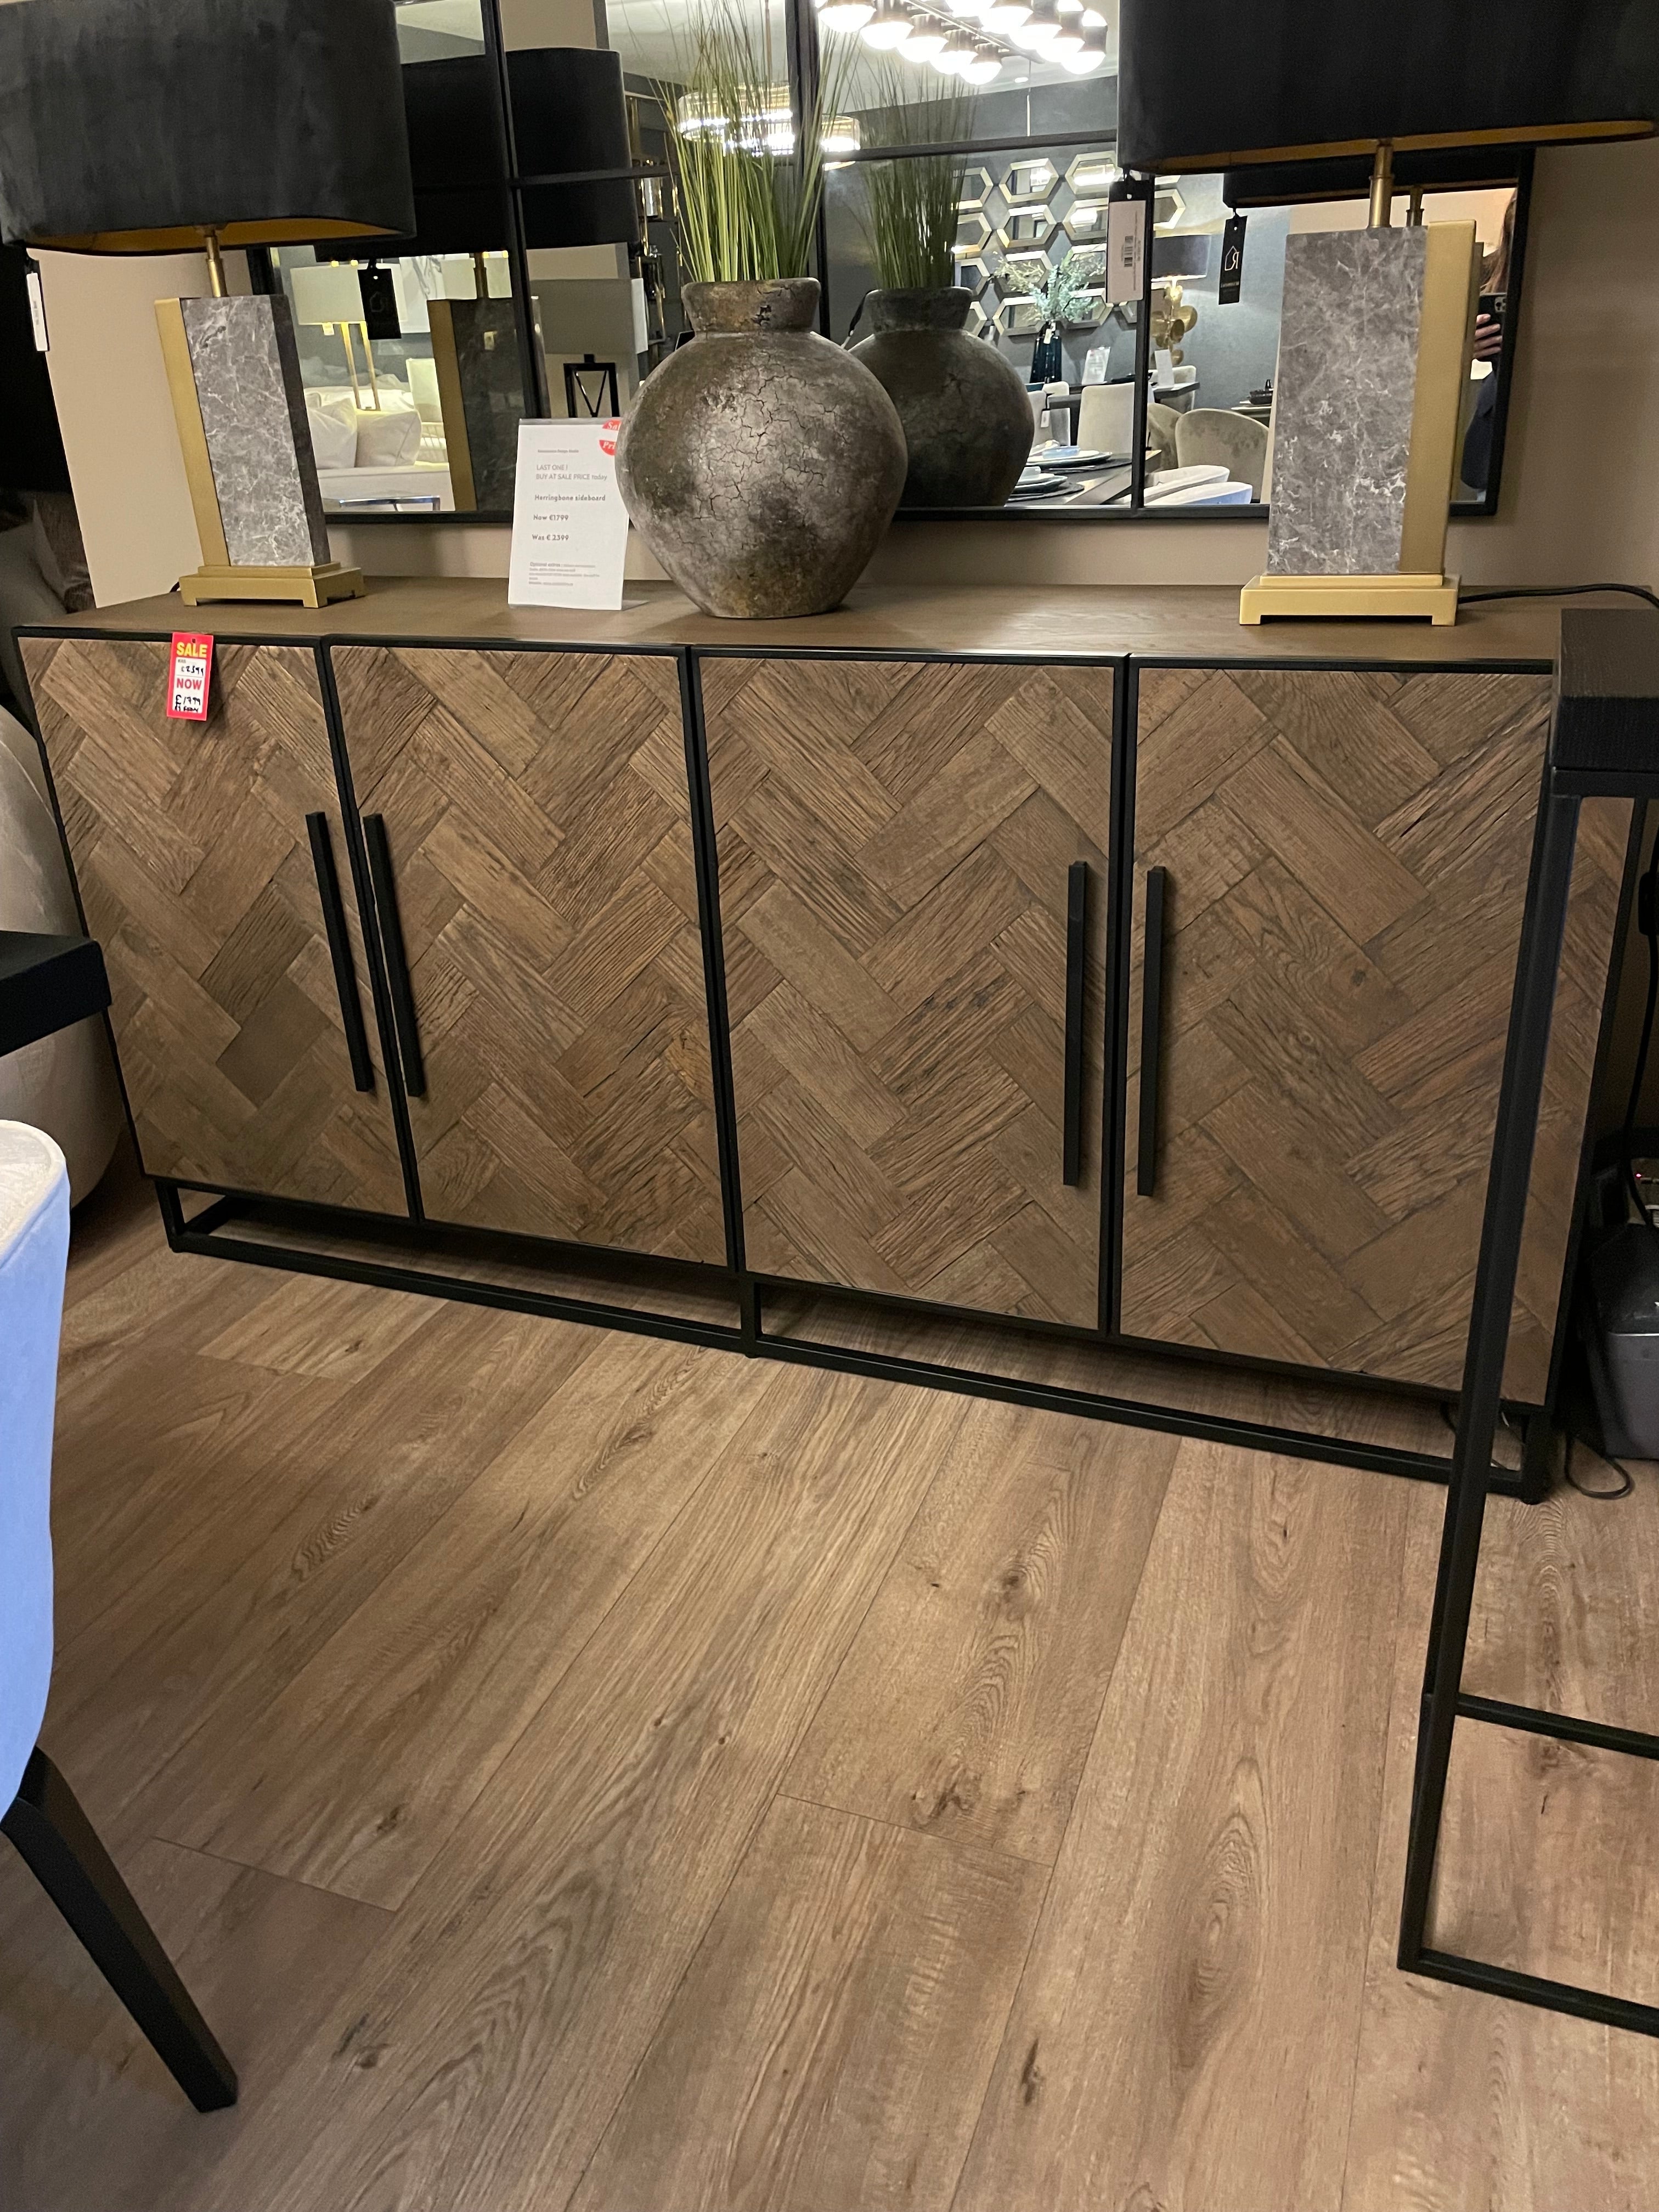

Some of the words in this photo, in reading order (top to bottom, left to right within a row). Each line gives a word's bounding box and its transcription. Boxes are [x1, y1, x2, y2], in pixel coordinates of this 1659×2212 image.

[534, 494, 573, 503] Herringbone
[176, 642, 207, 658] SALE
[176, 678, 202, 690] NOW
